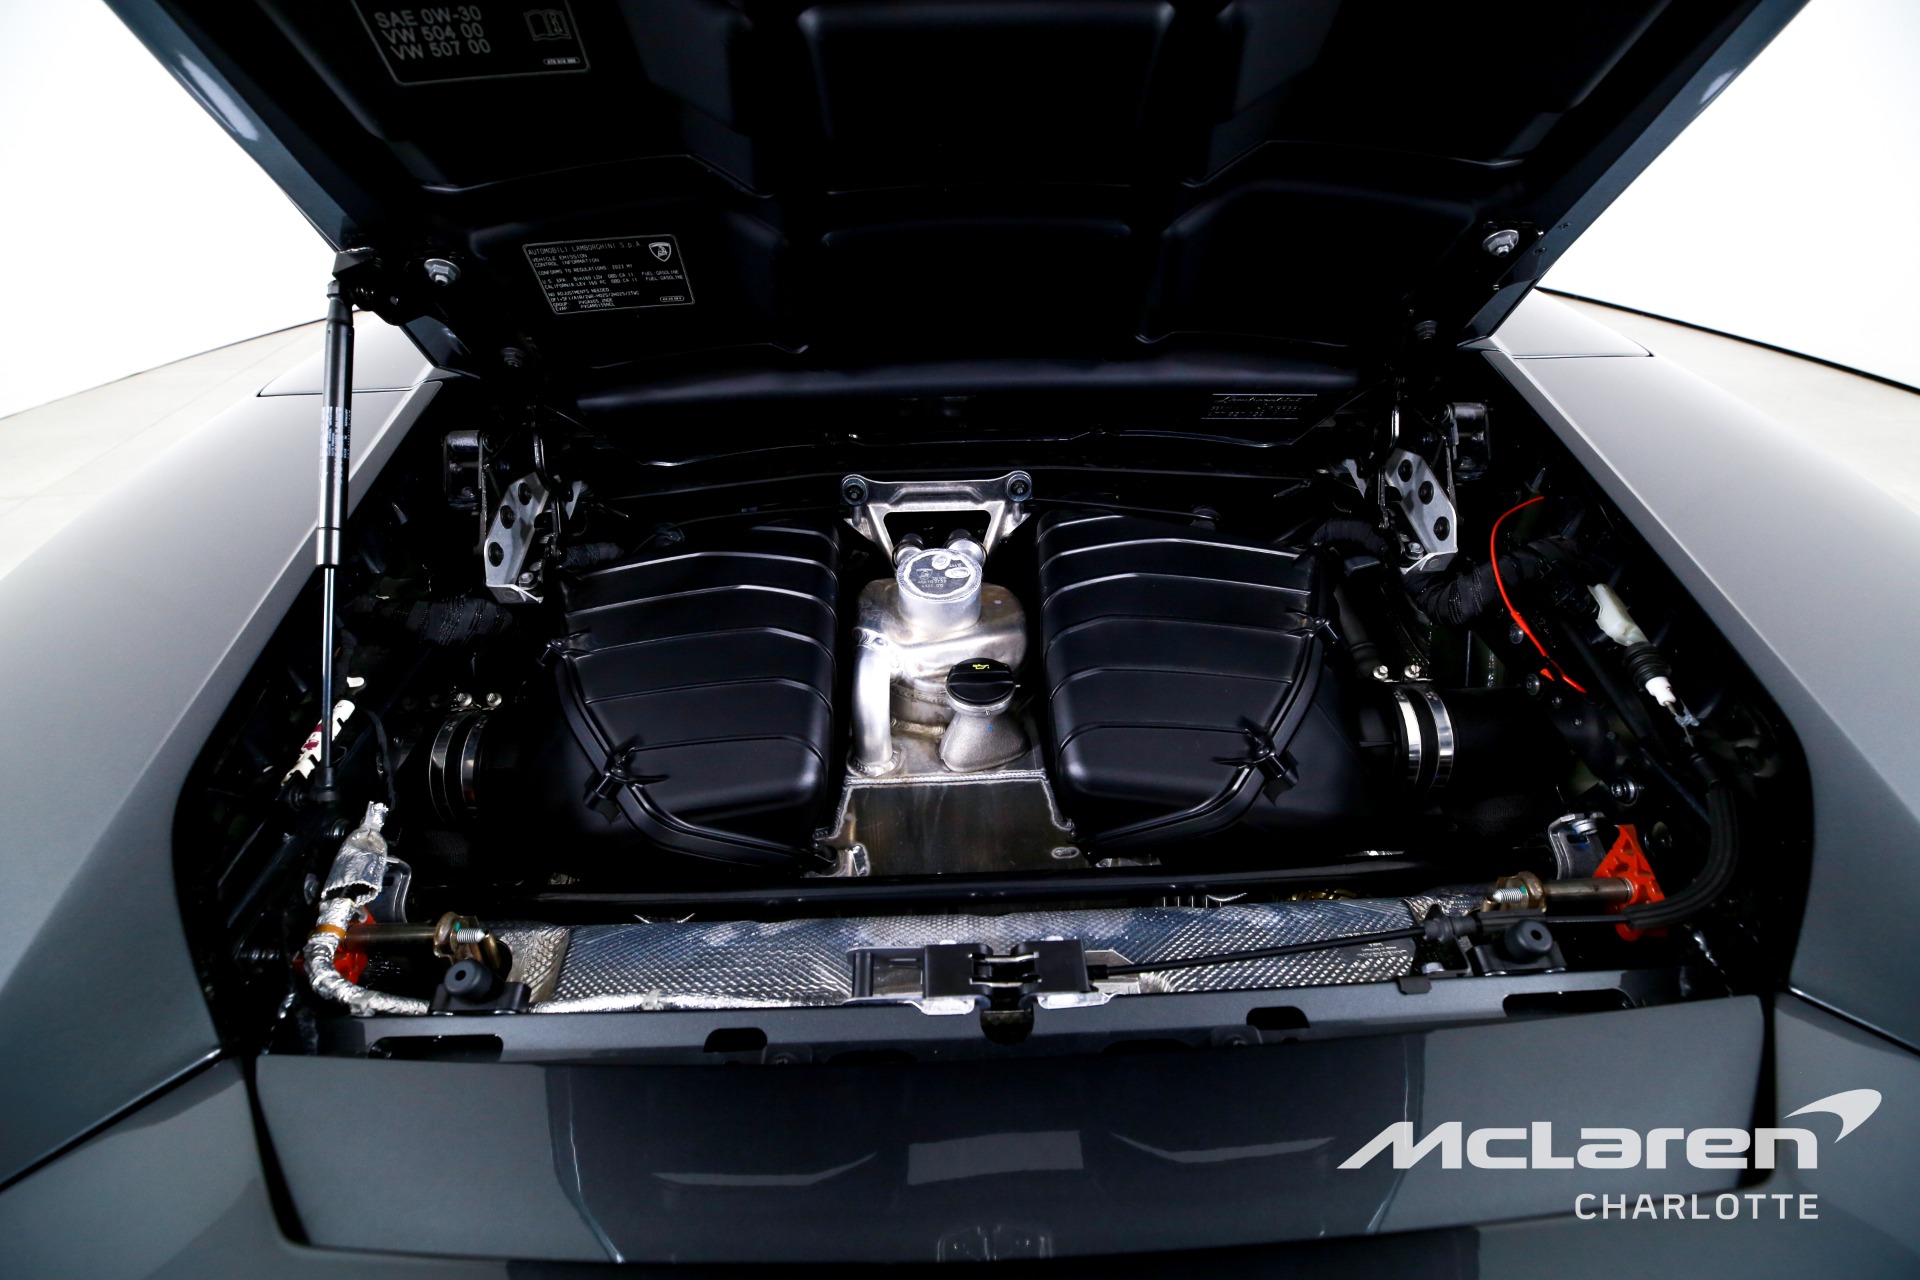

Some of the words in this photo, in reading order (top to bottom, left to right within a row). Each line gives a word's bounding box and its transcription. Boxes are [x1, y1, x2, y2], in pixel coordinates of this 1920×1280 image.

[374, 10, 418, 28] SAE
[420, 5, 482, 24] 0W-30
[381, 27, 416, 44] VW
[421, 24, 456, 41] 504
[460, 22, 484, 38] 00
[390, 43, 424, 60] VW
[429, 40, 460, 57] 507
[468, 38, 491, 54] 00
[528, 246, 568, 256] AUTOMOBILI
[572, 243, 616, 252] LAMBORGHINI
